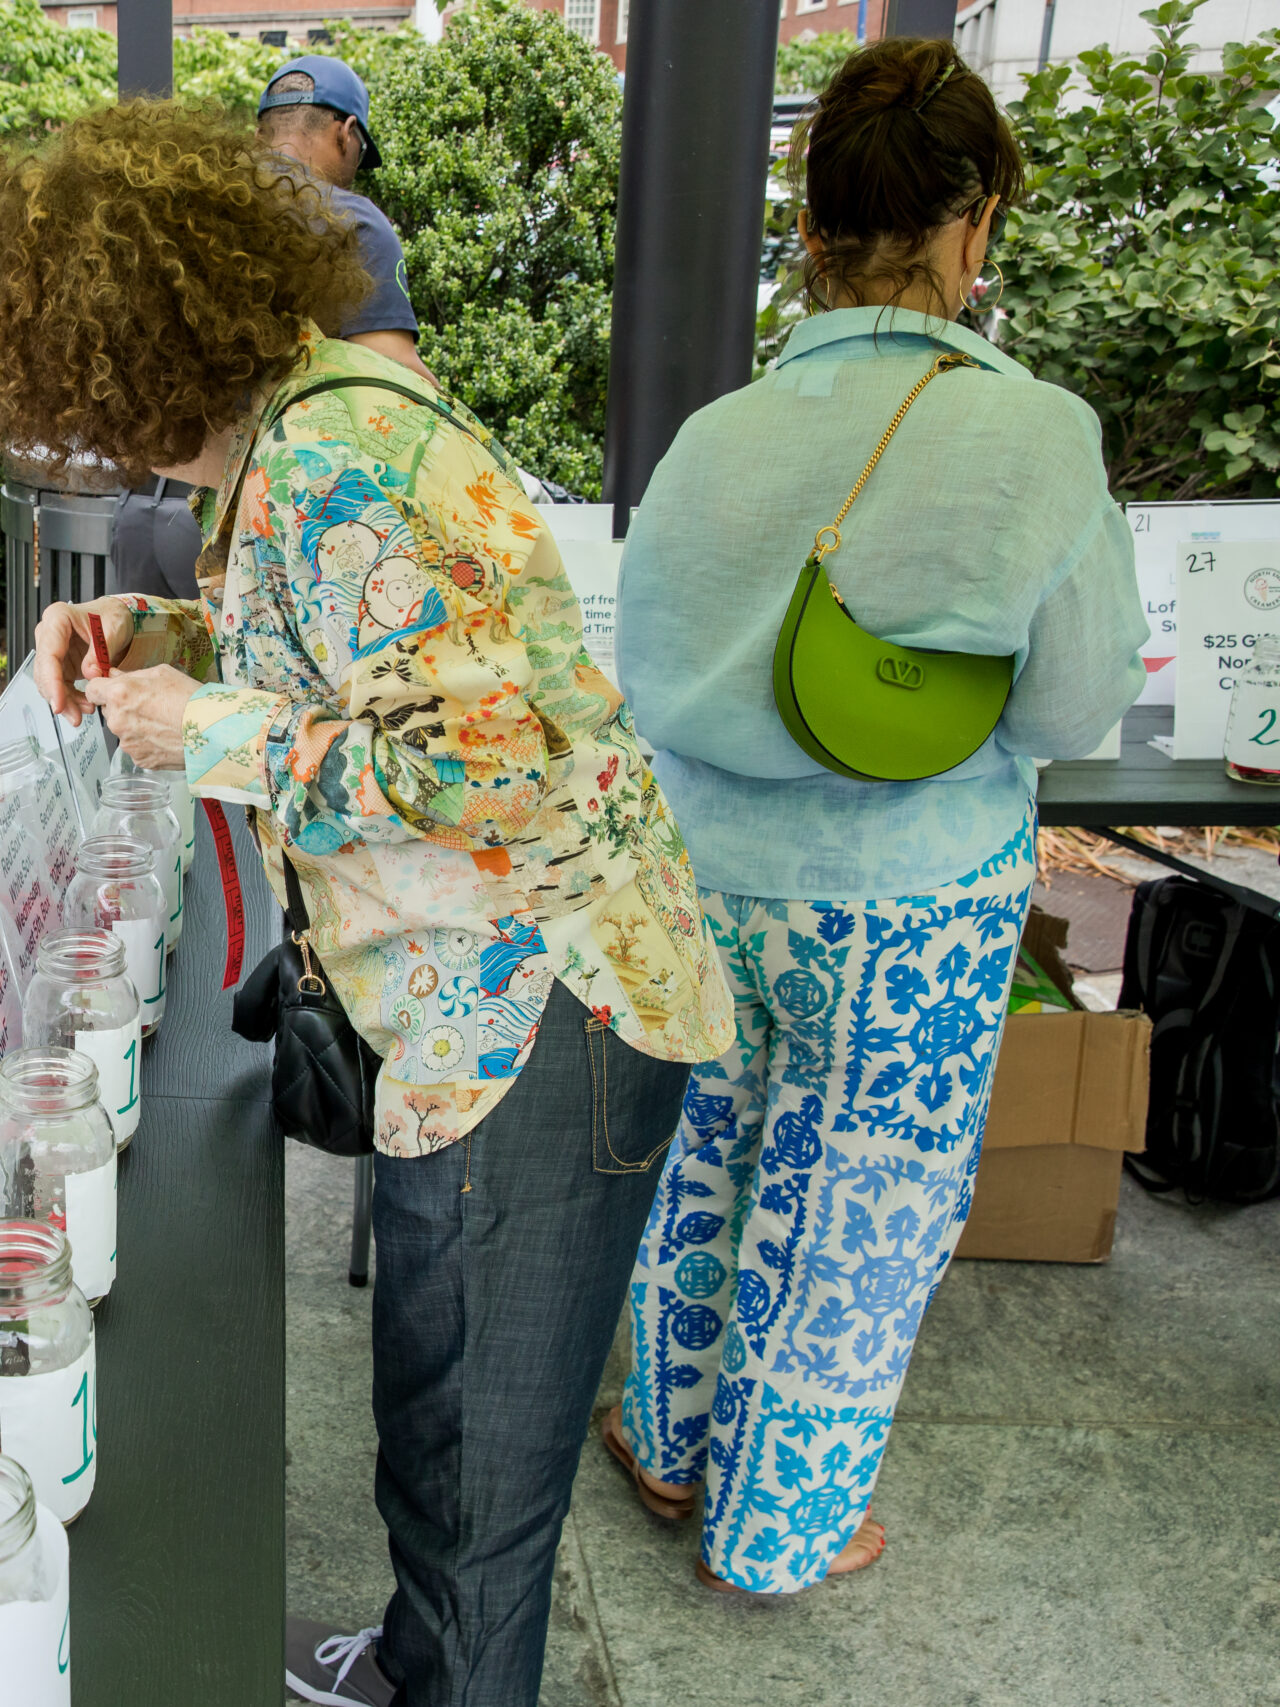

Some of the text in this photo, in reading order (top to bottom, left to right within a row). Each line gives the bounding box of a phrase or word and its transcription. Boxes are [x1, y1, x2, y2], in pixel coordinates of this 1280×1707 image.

[1135, 514, 1151, 532] 21
[1186, 551, 1217, 573] 27
[1250, 571, 1271, 583] NORTH
[583, 594, 615, 605] of fre
[1147, 600, 1176, 614] Lof
[585, 609, 611, 619] time
[1203, 634, 1238, 649] $25
[1218, 656, 1252, 670] Nor
[19, 928, 36, 976] August
[40, 895, 50, 922] Box
[2, 1016, 9, 1040] F
[62, 1371, 97, 1485] 1
